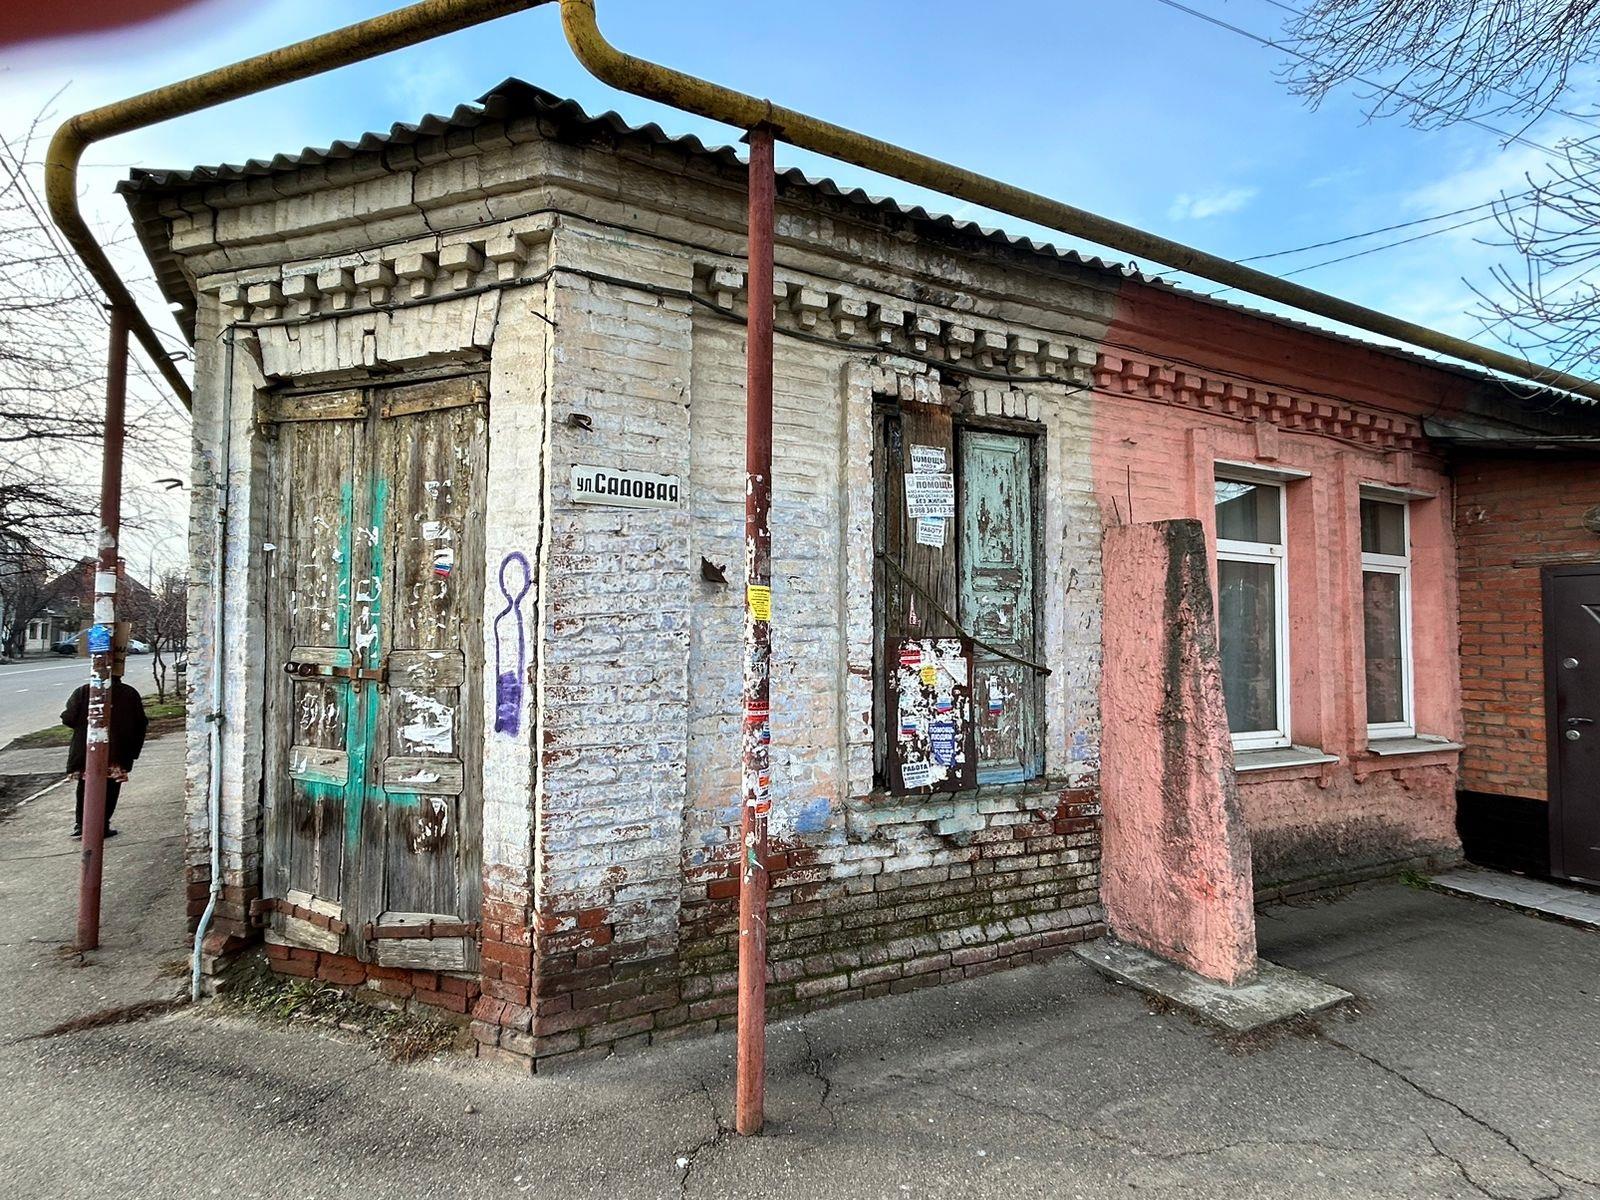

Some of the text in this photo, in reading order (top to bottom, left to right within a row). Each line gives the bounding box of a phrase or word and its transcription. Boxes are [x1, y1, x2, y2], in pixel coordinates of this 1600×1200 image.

[916, 481, 952, 489] ПОМОЩЬ
[920, 526, 942, 534] РАБОТУ
[903, 764, 928, 772] РАБОТА
